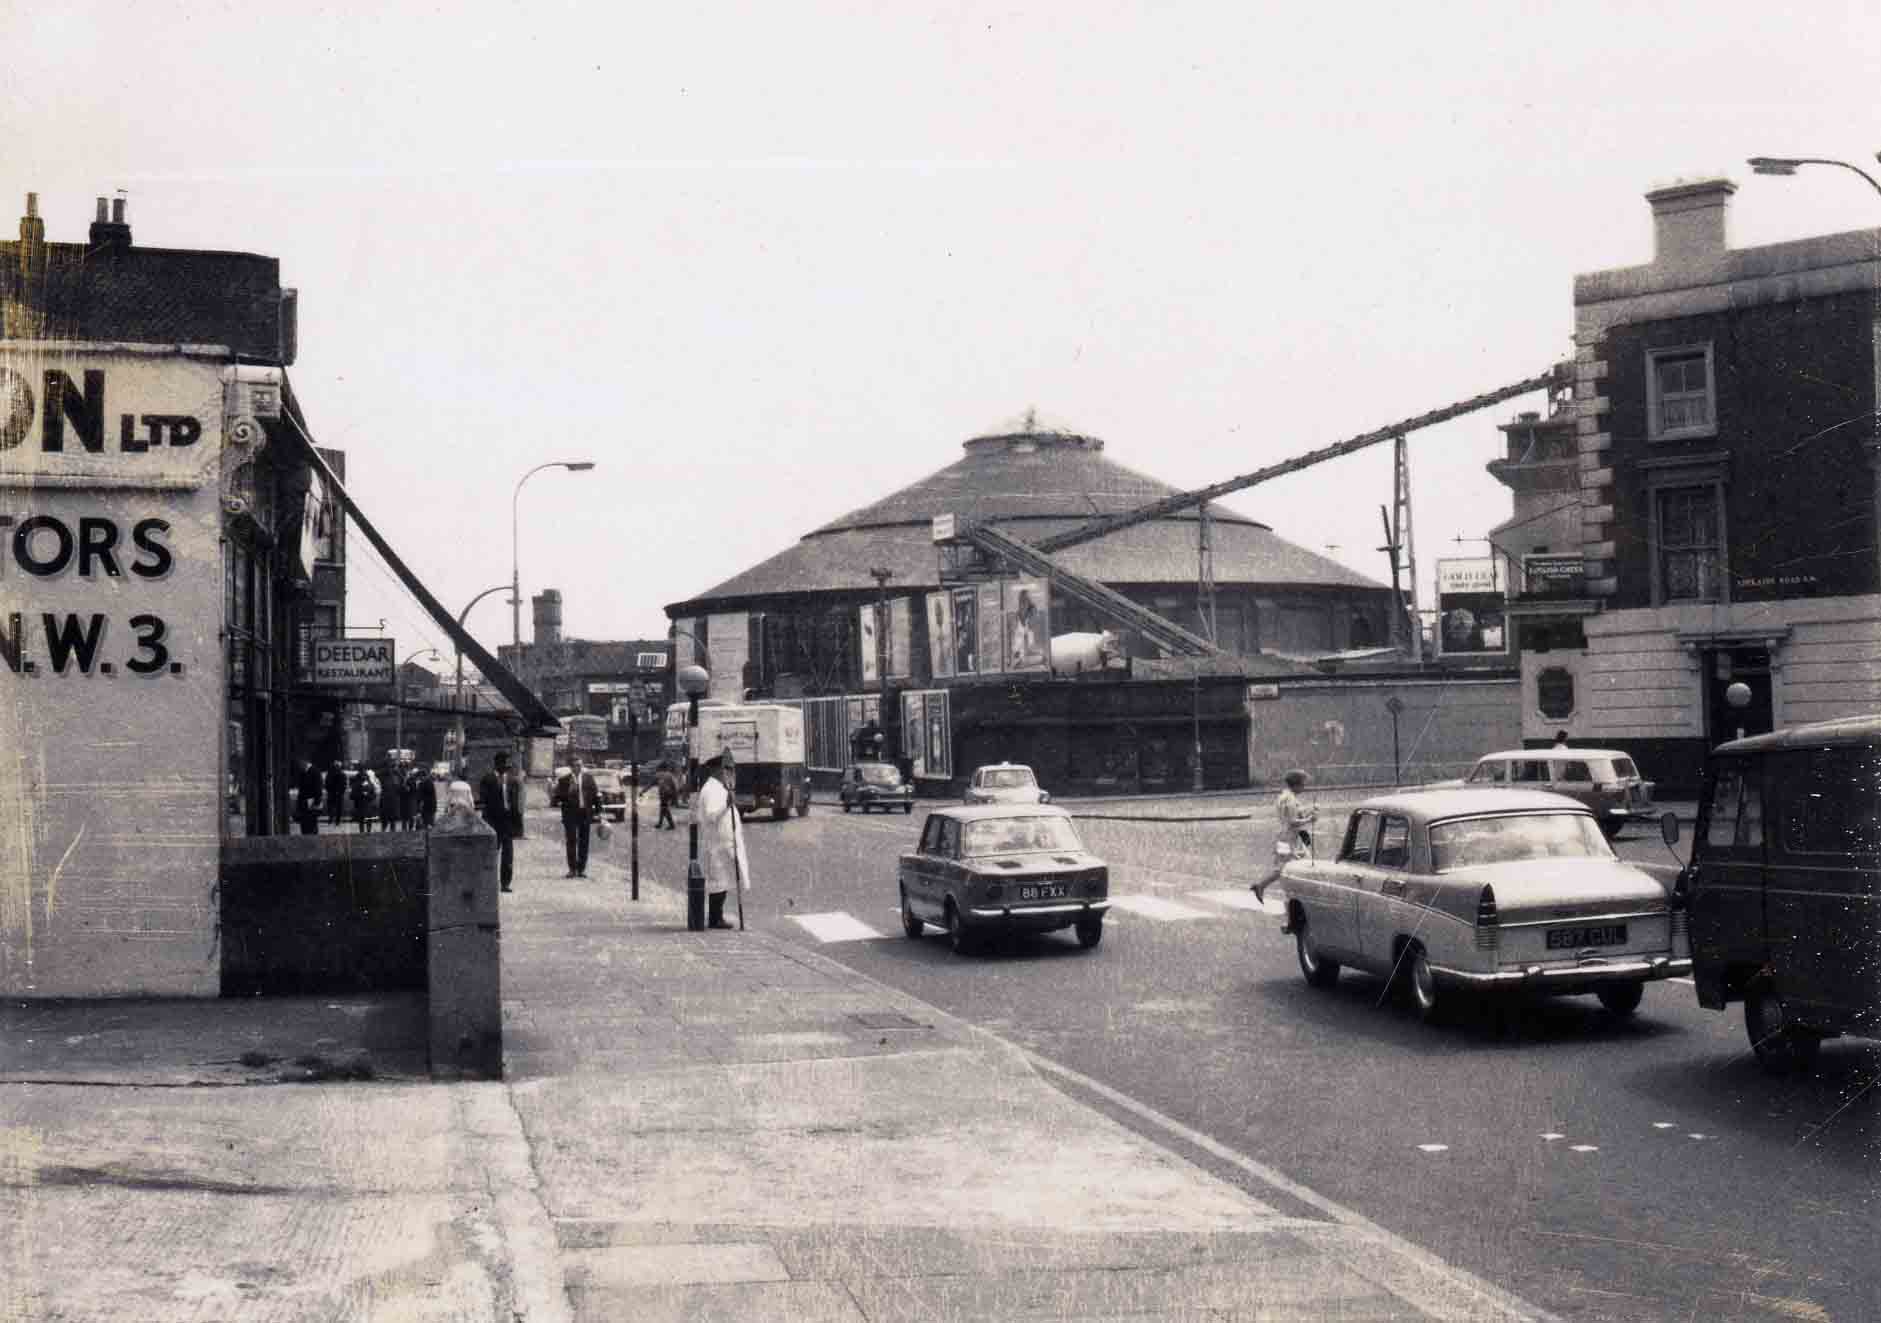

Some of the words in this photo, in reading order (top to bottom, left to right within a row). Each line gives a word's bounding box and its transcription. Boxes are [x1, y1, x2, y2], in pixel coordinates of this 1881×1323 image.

[120, 414, 202, 453] LTD
[318, 645, 391, 663] DEEDAR
[318, 666, 392, 679] RESTAURANT
